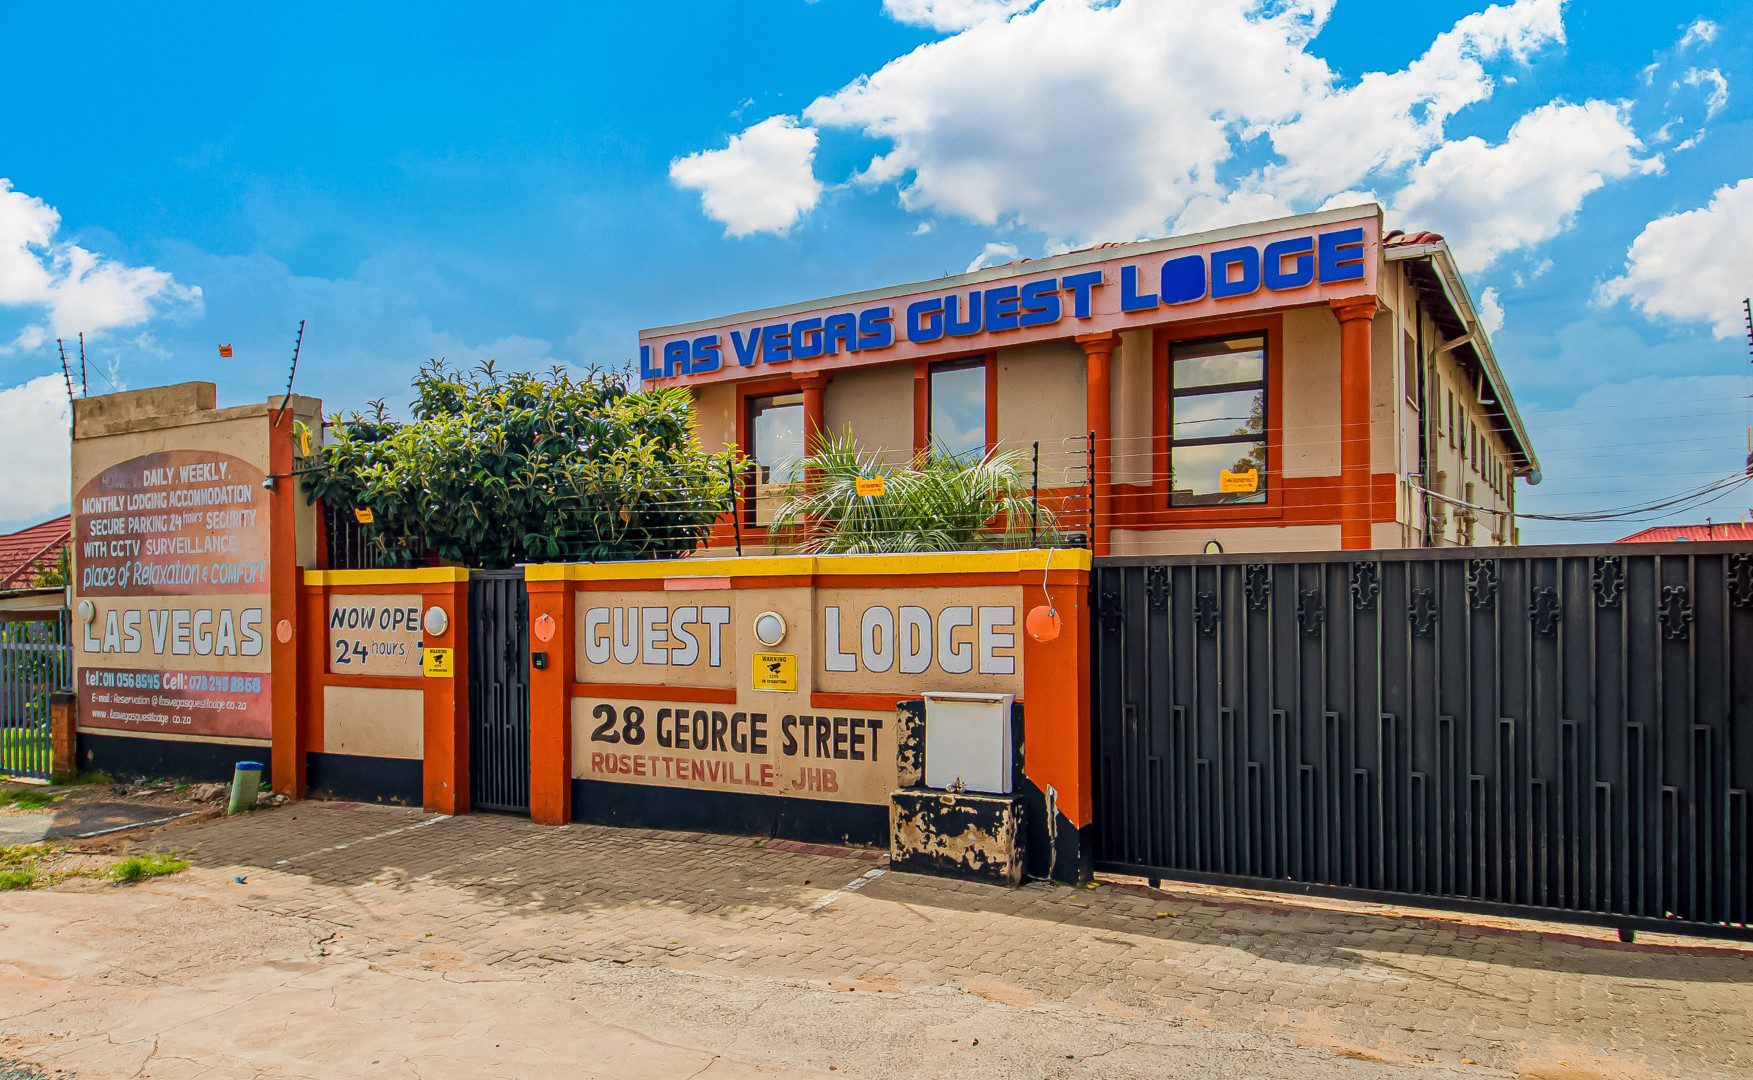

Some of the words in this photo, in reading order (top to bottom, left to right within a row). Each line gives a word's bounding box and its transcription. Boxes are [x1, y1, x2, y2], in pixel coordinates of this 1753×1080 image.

[640, 335, 723, 381] LAS
[730, 306, 896, 367] VEGAS
[907, 270, 1104, 344] GUEST
[1121, 227, 1366, 313] LODGE
[82, 495, 126, 514] MONTHLY
[127, 491, 168, 511] LODGING
[169, 484, 252, 507] ACCOMMODATION
[90, 517, 126, 536] SECURE
[128, 514, 168, 534] PARKING
[169, 513, 182, 531] 24
[182, 510, 203, 523] hours
[205, 509, 257, 530] SECURITY
[84, 541, 108, 558] WITH
[110, 539, 140, 557] CCTV
[145, 535, 240, 556] SURVEILLANCE
[83, 564, 117, 591] place
[118, 560, 131, 588] of
[132, 559, 200, 586] Relaxation
[83, 609, 142, 653] LAS
[148, 608, 264, 656] VEGAS
[330, 606, 377, 631] NOW
[379, 606, 423, 631] OPE
[335, 638, 369, 665] 24
[584, 605, 731, 668] GUEST
[824, 605, 1015, 675] LODGE
[116, 672, 135, 688] 056
[591, 703, 646, 745] 28
[656, 708, 768, 755] GEORGE
[781, 714, 883, 762] STREET
[591, 751, 774, 788] ROSETTENVILLE
[791, 766, 839, 794] JHB
